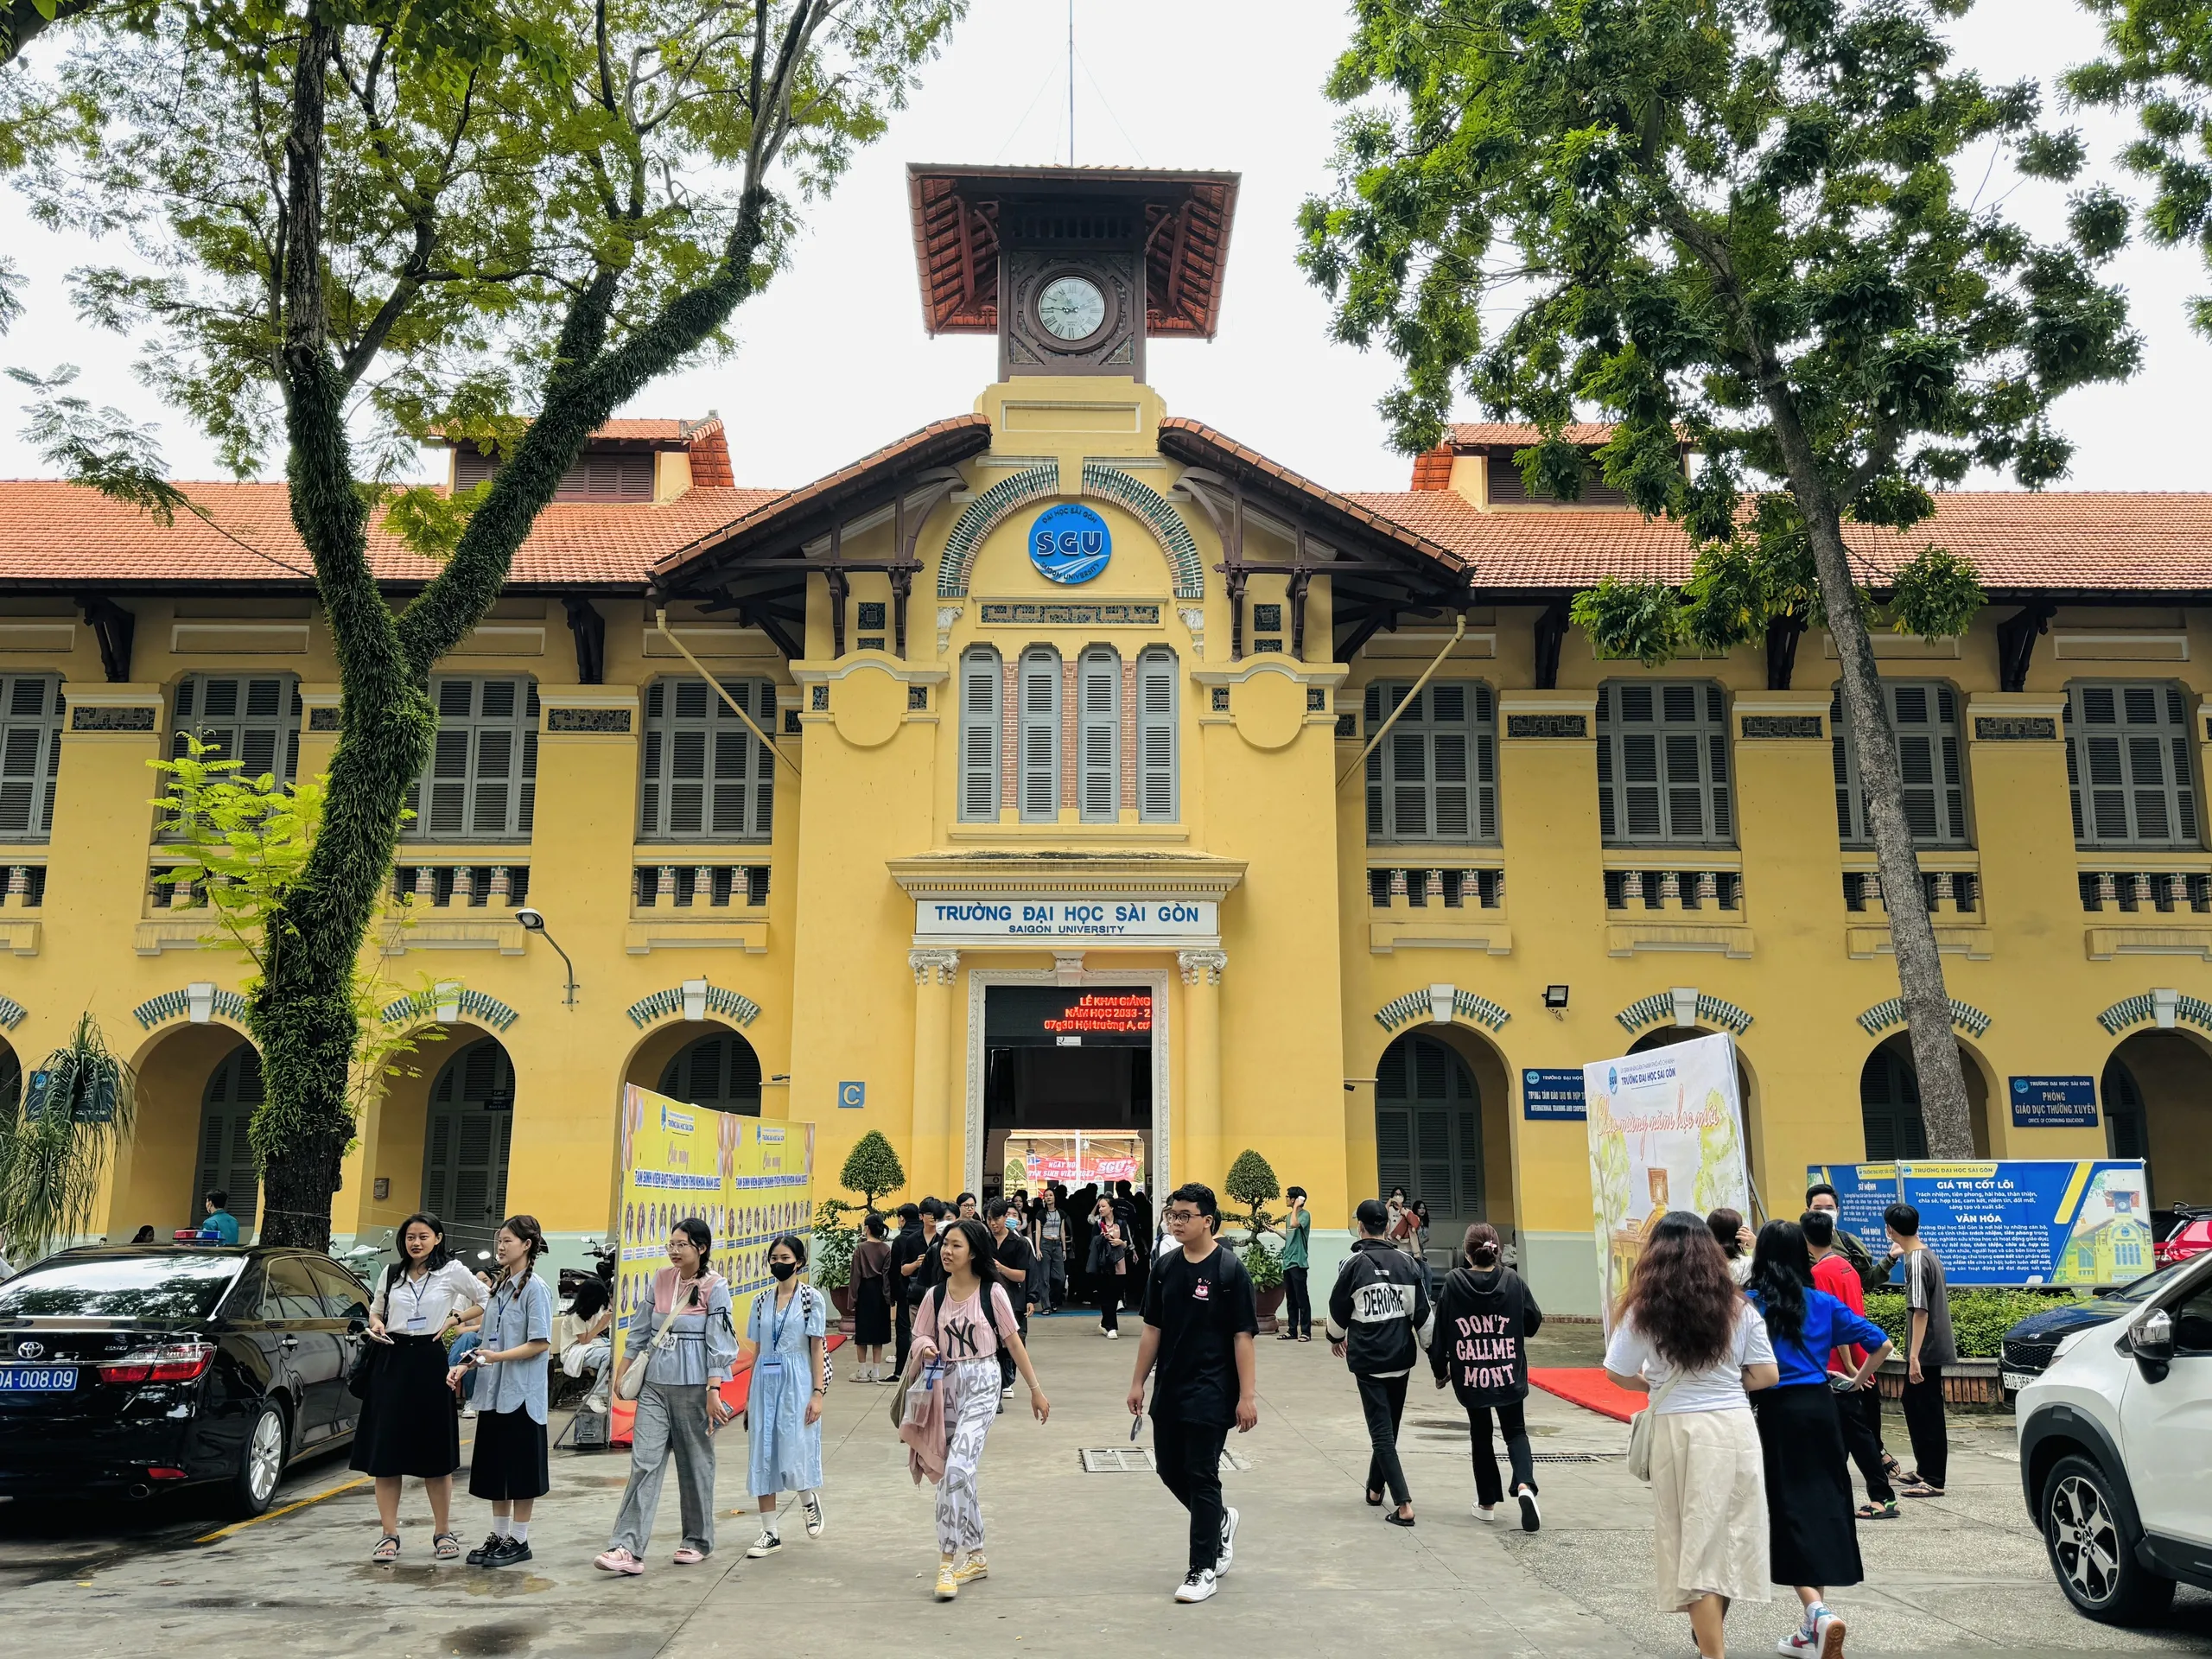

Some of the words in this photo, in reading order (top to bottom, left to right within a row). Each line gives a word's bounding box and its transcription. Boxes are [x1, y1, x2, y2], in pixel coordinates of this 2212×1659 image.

[1036, 531, 1102, 555] SGU
[1064, 563, 1099, 580] UNIVERSITY
[935, 902, 1011, 921] TRƯỜNG
[1023, 906, 1053, 924] ĐẠI
[1065, 906, 1103, 925] HỌC
[1116, 903, 1145, 921] SÀI
[1158, 903, 1198, 922] GÒN
[1090, 1008, 1111, 1019] HỌC
[843, 1085, 860, 1105] C
[2043, 1090, 2065, 1101] PHÒNG
[2015, 1103, 2031, 1114] GIÁO
[2047, 1103, 2072, 1114] THƯỜNG
[2074, 1103, 2095, 1114] XUYÊN
[1937, 1180, 1955, 1189] GIÁ
[1956, 1182, 1972, 1191] TRỊ
[1975, 1179, 1995, 1189] CỐT
[1998, 1179, 2013, 1189] LÕI
[1955, 1214, 1978, 1223] VĂN
[1980, 1213, 2002, 1223] HÓA
[1455, 1314, 1510, 1338] DON'T
[1464, 1363, 1515, 1388] MONT
